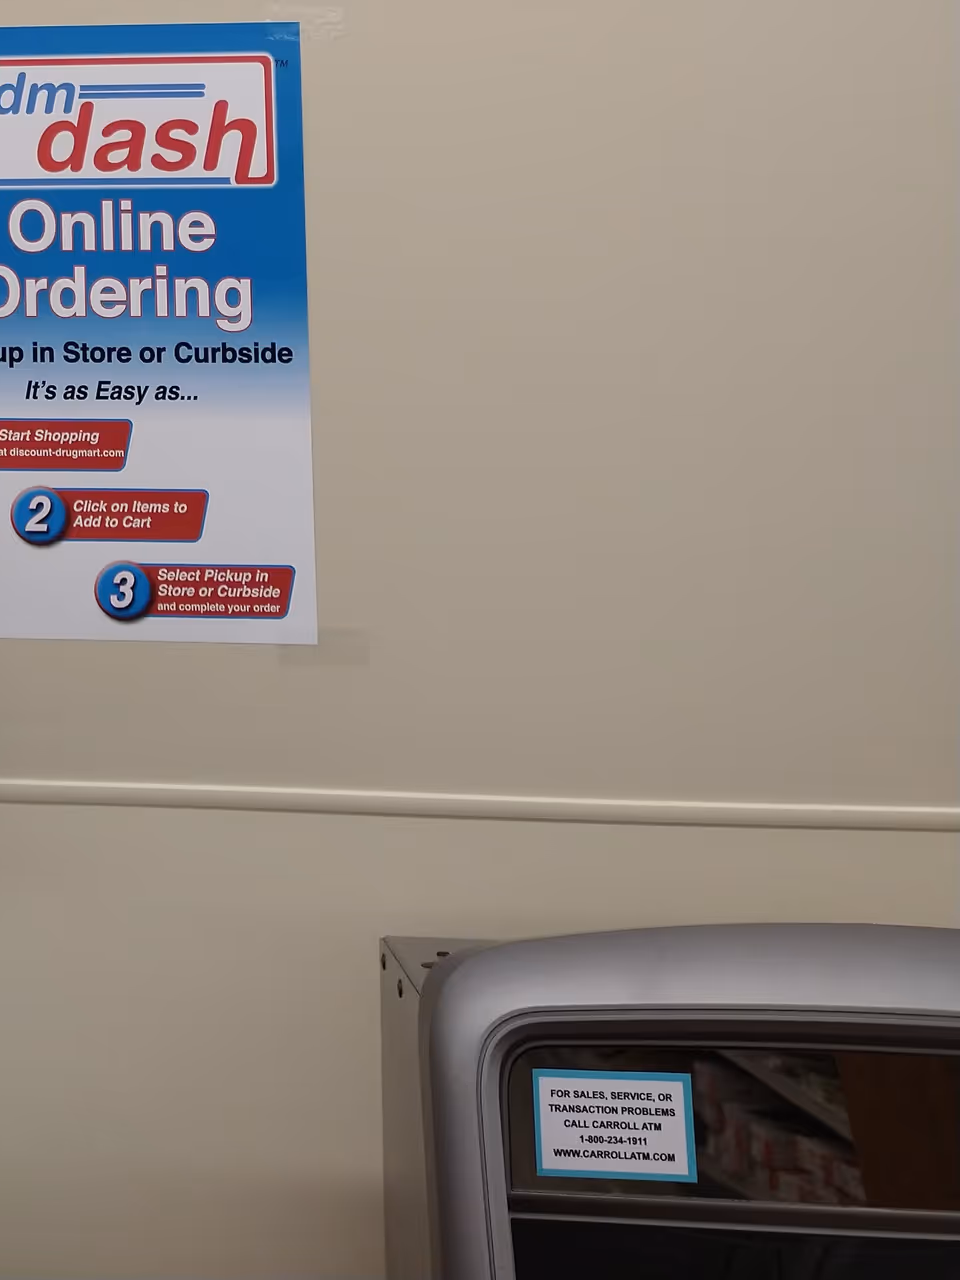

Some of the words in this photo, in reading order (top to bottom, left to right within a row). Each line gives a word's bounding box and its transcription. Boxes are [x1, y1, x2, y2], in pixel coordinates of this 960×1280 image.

[36, 99, 258, 176] dash
[8, 198, 216, 253] Online
[32, 342, 54, 363] in
[63, 342, 132, 363] Store
[139, 347, 167, 363] or
[174, 342, 293, 364] Curbside
[63, 386, 88, 401] as
[96, 381, 149, 405] Easy
[155, 386, 198, 401] as...
[0, 429, 30, 442] Start
[34, 429, 99, 444] Shopping
[10, 447, 124, 459] discount-drugmart.com
[73, 500, 107, 513] Click
[111, 503, 128, 513] on
[133, 501, 170, 513] Items
[173, 502, 187, 513] to
[24, 496, 52, 531] 2
[73, 516, 101, 528] Add
[105, 517, 119, 528] to
[123, 516, 151, 529] Cart
[158, 569, 201, 582] Select
[205, 570, 252, 584] Pickup
[256, 570, 269, 583] in
[110, 571, 135, 608] 3
[158, 585, 195, 597] Store
[199, 587, 213, 597] or
[217, 585, 280, 598] Curbside
[158, 603, 175, 612] and
[178, 603, 225, 613] complete
[228, 605, 250, 614] your
[253, 604, 280, 613] order
[550, 1089, 570, 1099] FOR
[573, 1090, 608, 1101] SALES,
[611, 1091, 655, 1103] SERVICE,
[658, 1093, 672, 1102] OR
[548, 1104, 618, 1114] TRANSACTION
[621, 1107, 675, 1117] PROBLEMS
[564, 1119, 589, 1128] CALL
[592, 1121, 639, 1131] CARROLL
[641, 1122, 662, 1131] ATM
[579, 1135, 647, 1146] 1-800-234-1911
[553, 1149, 675, 1162] WWW.CARROLLATM.COM
